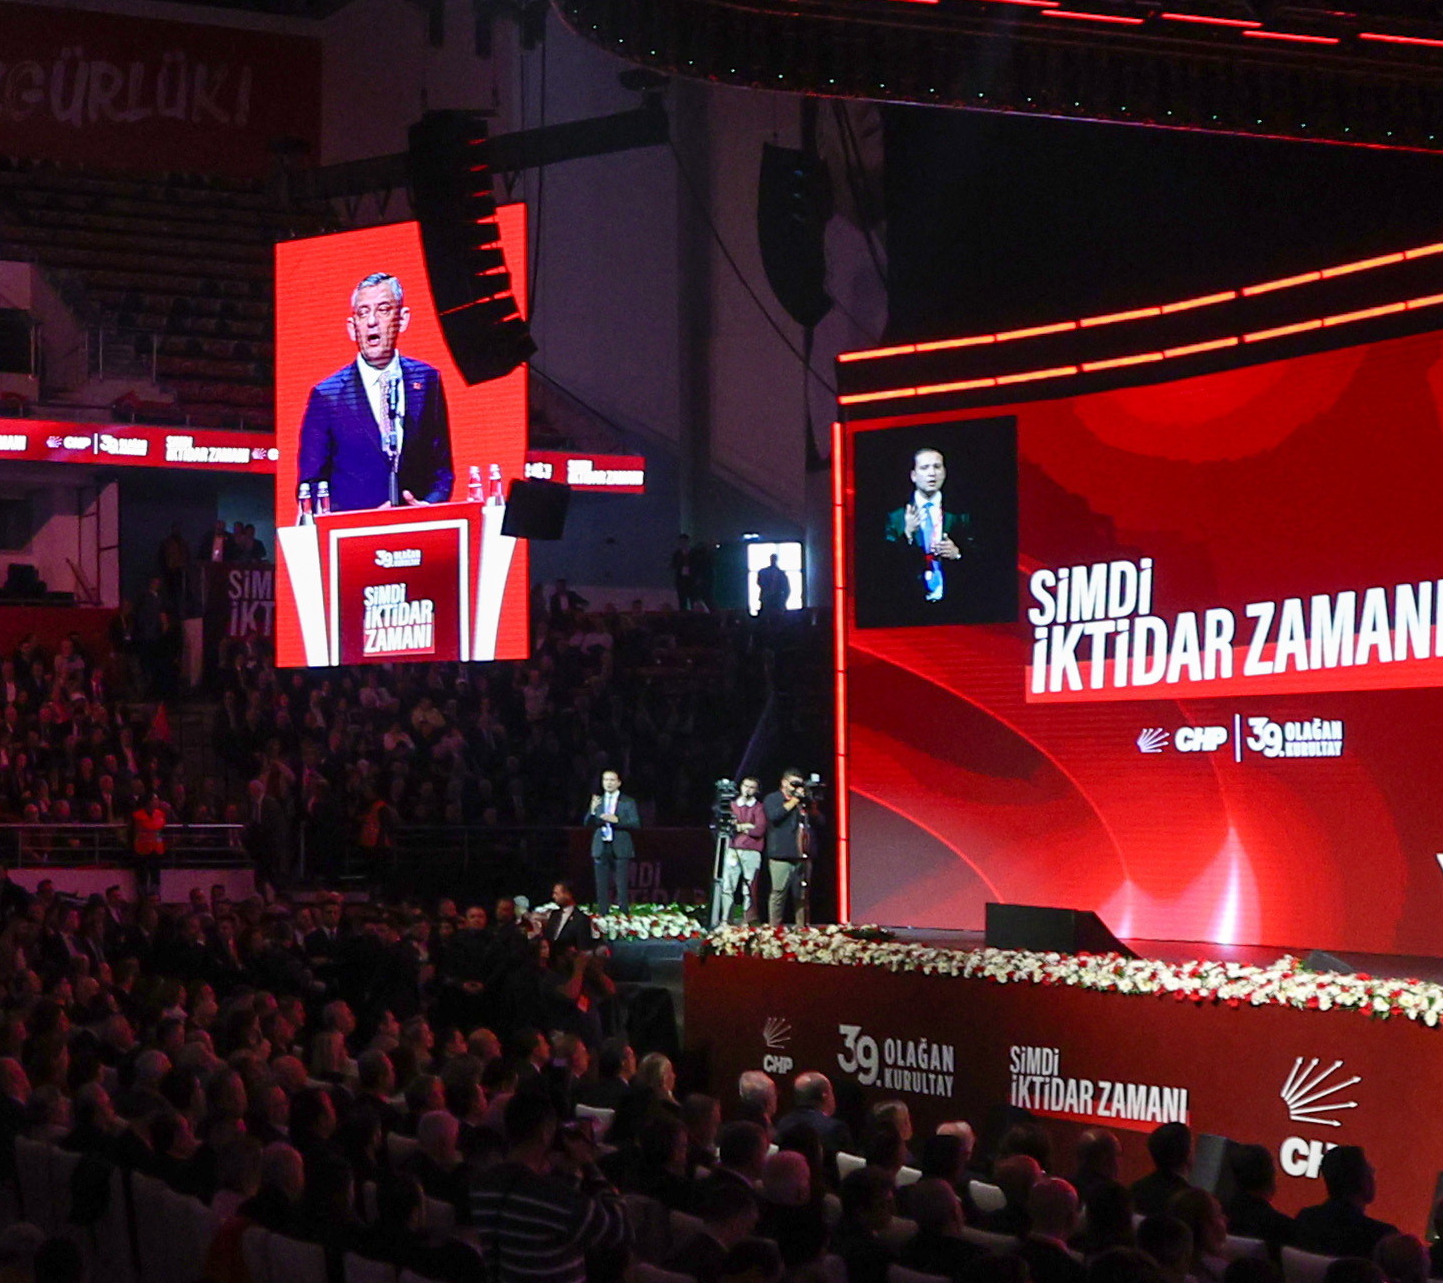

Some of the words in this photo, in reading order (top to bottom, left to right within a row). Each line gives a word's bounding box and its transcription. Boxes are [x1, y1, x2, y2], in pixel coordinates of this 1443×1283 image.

[363, 622, 433, 653] ZAMANI
[1174, 726, 1228, 752] CHP
[1284, 717, 1343, 741] OLAĞAN
[763, 1053, 793, 1075] CHP
[837, 1024, 883, 1088] 39.
[883, 1037, 954, 1073] OLAĞAN
[884, 1067, 954, 1098] KURULTAY
[1096, 1081, 1189, 1125] ZAMANI
